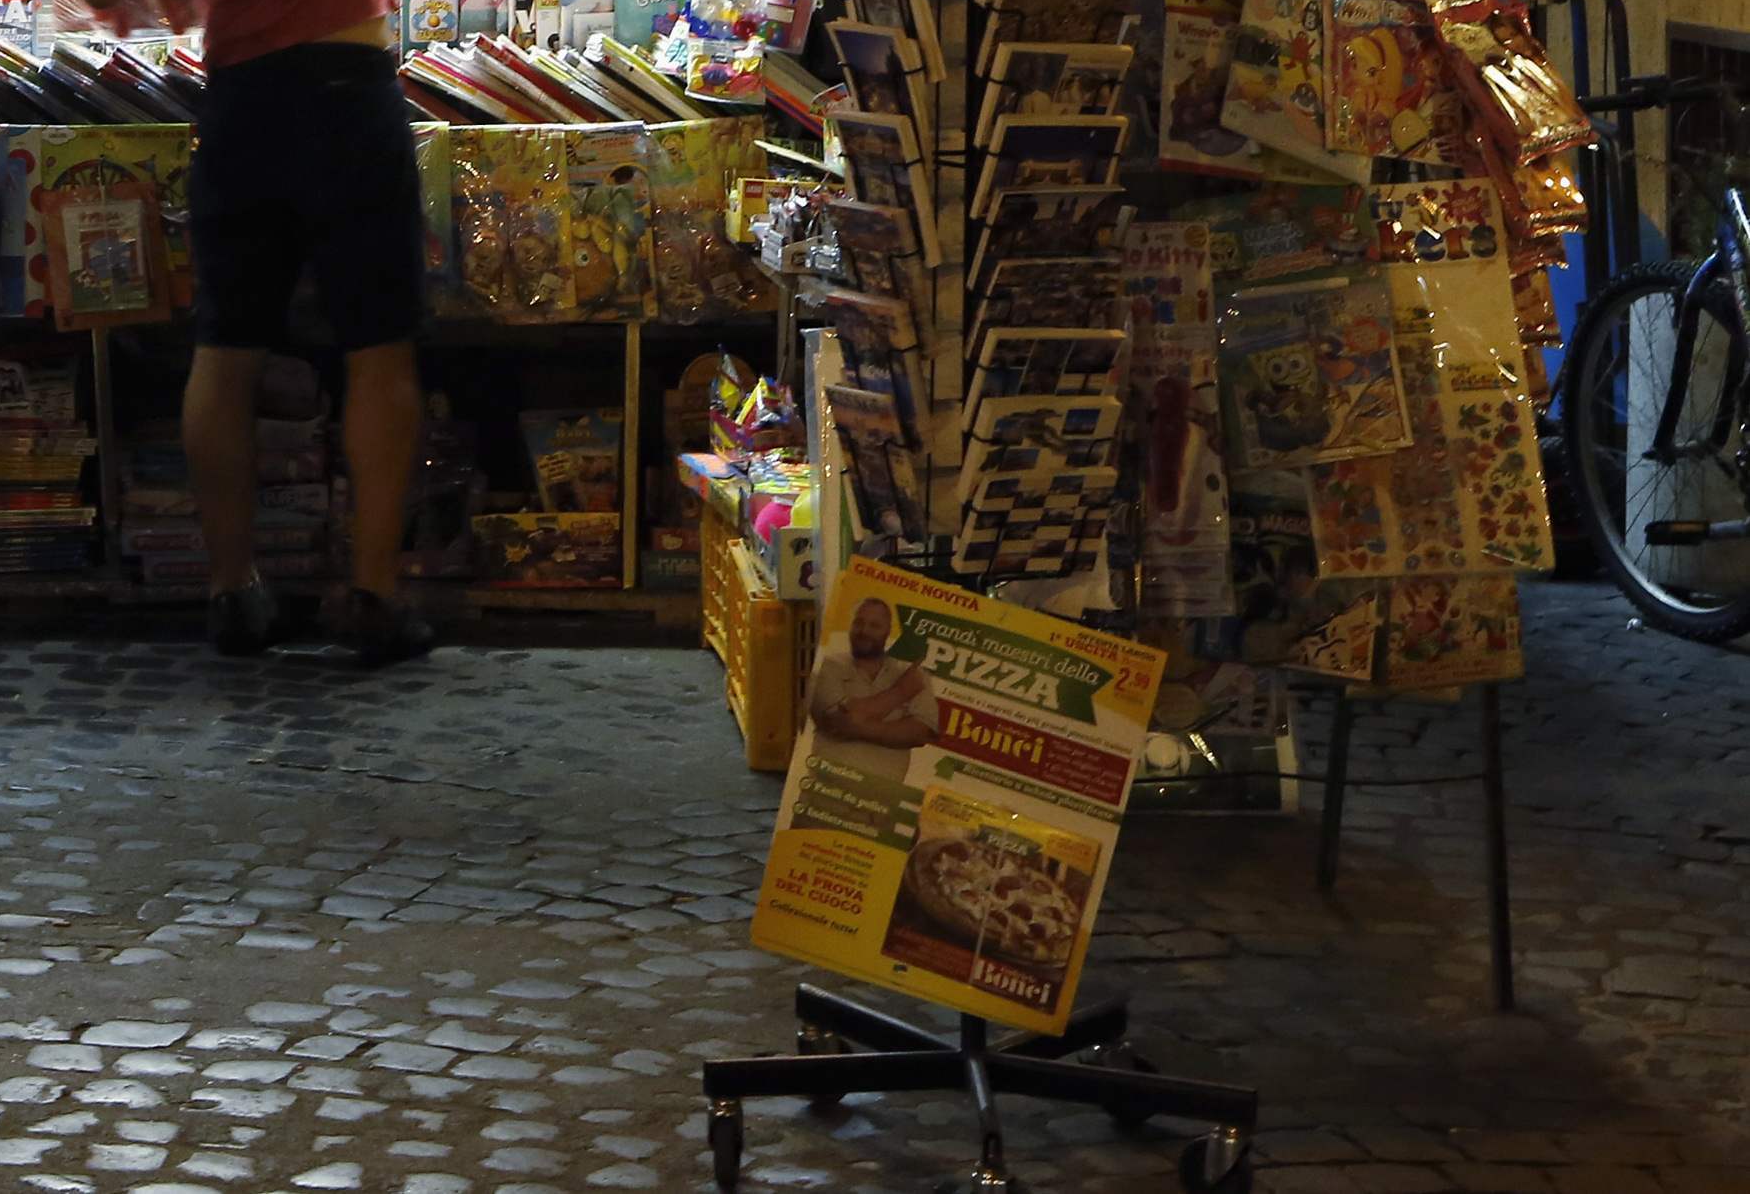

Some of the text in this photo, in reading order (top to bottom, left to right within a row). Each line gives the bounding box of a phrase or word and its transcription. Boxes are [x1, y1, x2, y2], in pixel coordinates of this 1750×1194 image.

[854, 562, 919, 592] GRANDE
[914, 618, 981, 648] grandi
[981, 637, 1054, 669] maestri
[1054, 656, 1101, 687] della
[1065, 636, 1119, 662] USCITA
[920, 637, 1061, 711] PIZZA
[945, 707, 1046, 765] Bonci
[774, 876, 863, 915] DEL CUOCO
[787, 867, 866, 902] LA PROVA
[976, 958, 1052, 1005] Bonci
